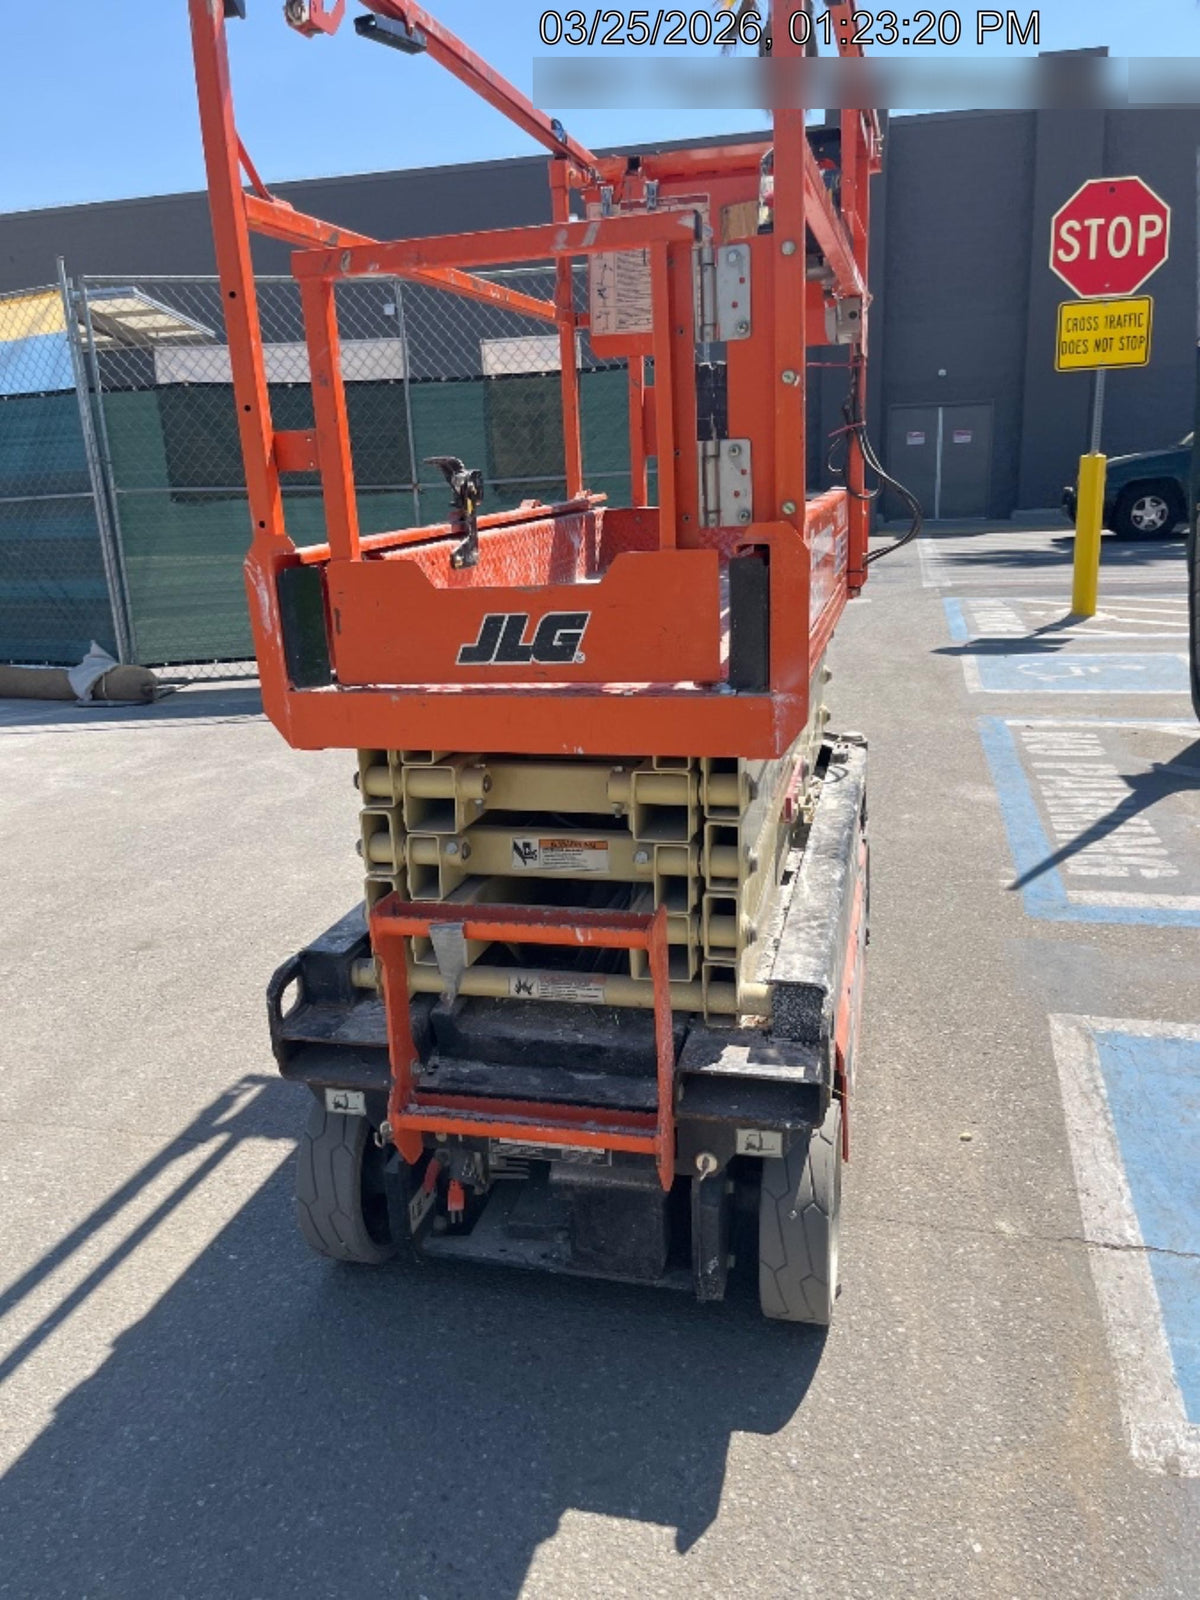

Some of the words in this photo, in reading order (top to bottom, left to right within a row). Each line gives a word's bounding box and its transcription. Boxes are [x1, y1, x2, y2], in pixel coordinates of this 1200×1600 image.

[1057, 214, 1163, 262] STOP
[1065, 315, 1099, 333] CROSS
[1104, 312, 1144, 330] TRAFFIC
[1061, 339, 1089, 356] DOES
[1094, 337, 1114, 353] NOT
[1119, 335, 1146, 351] STOP
[456, 611, 591, 665] JLG
